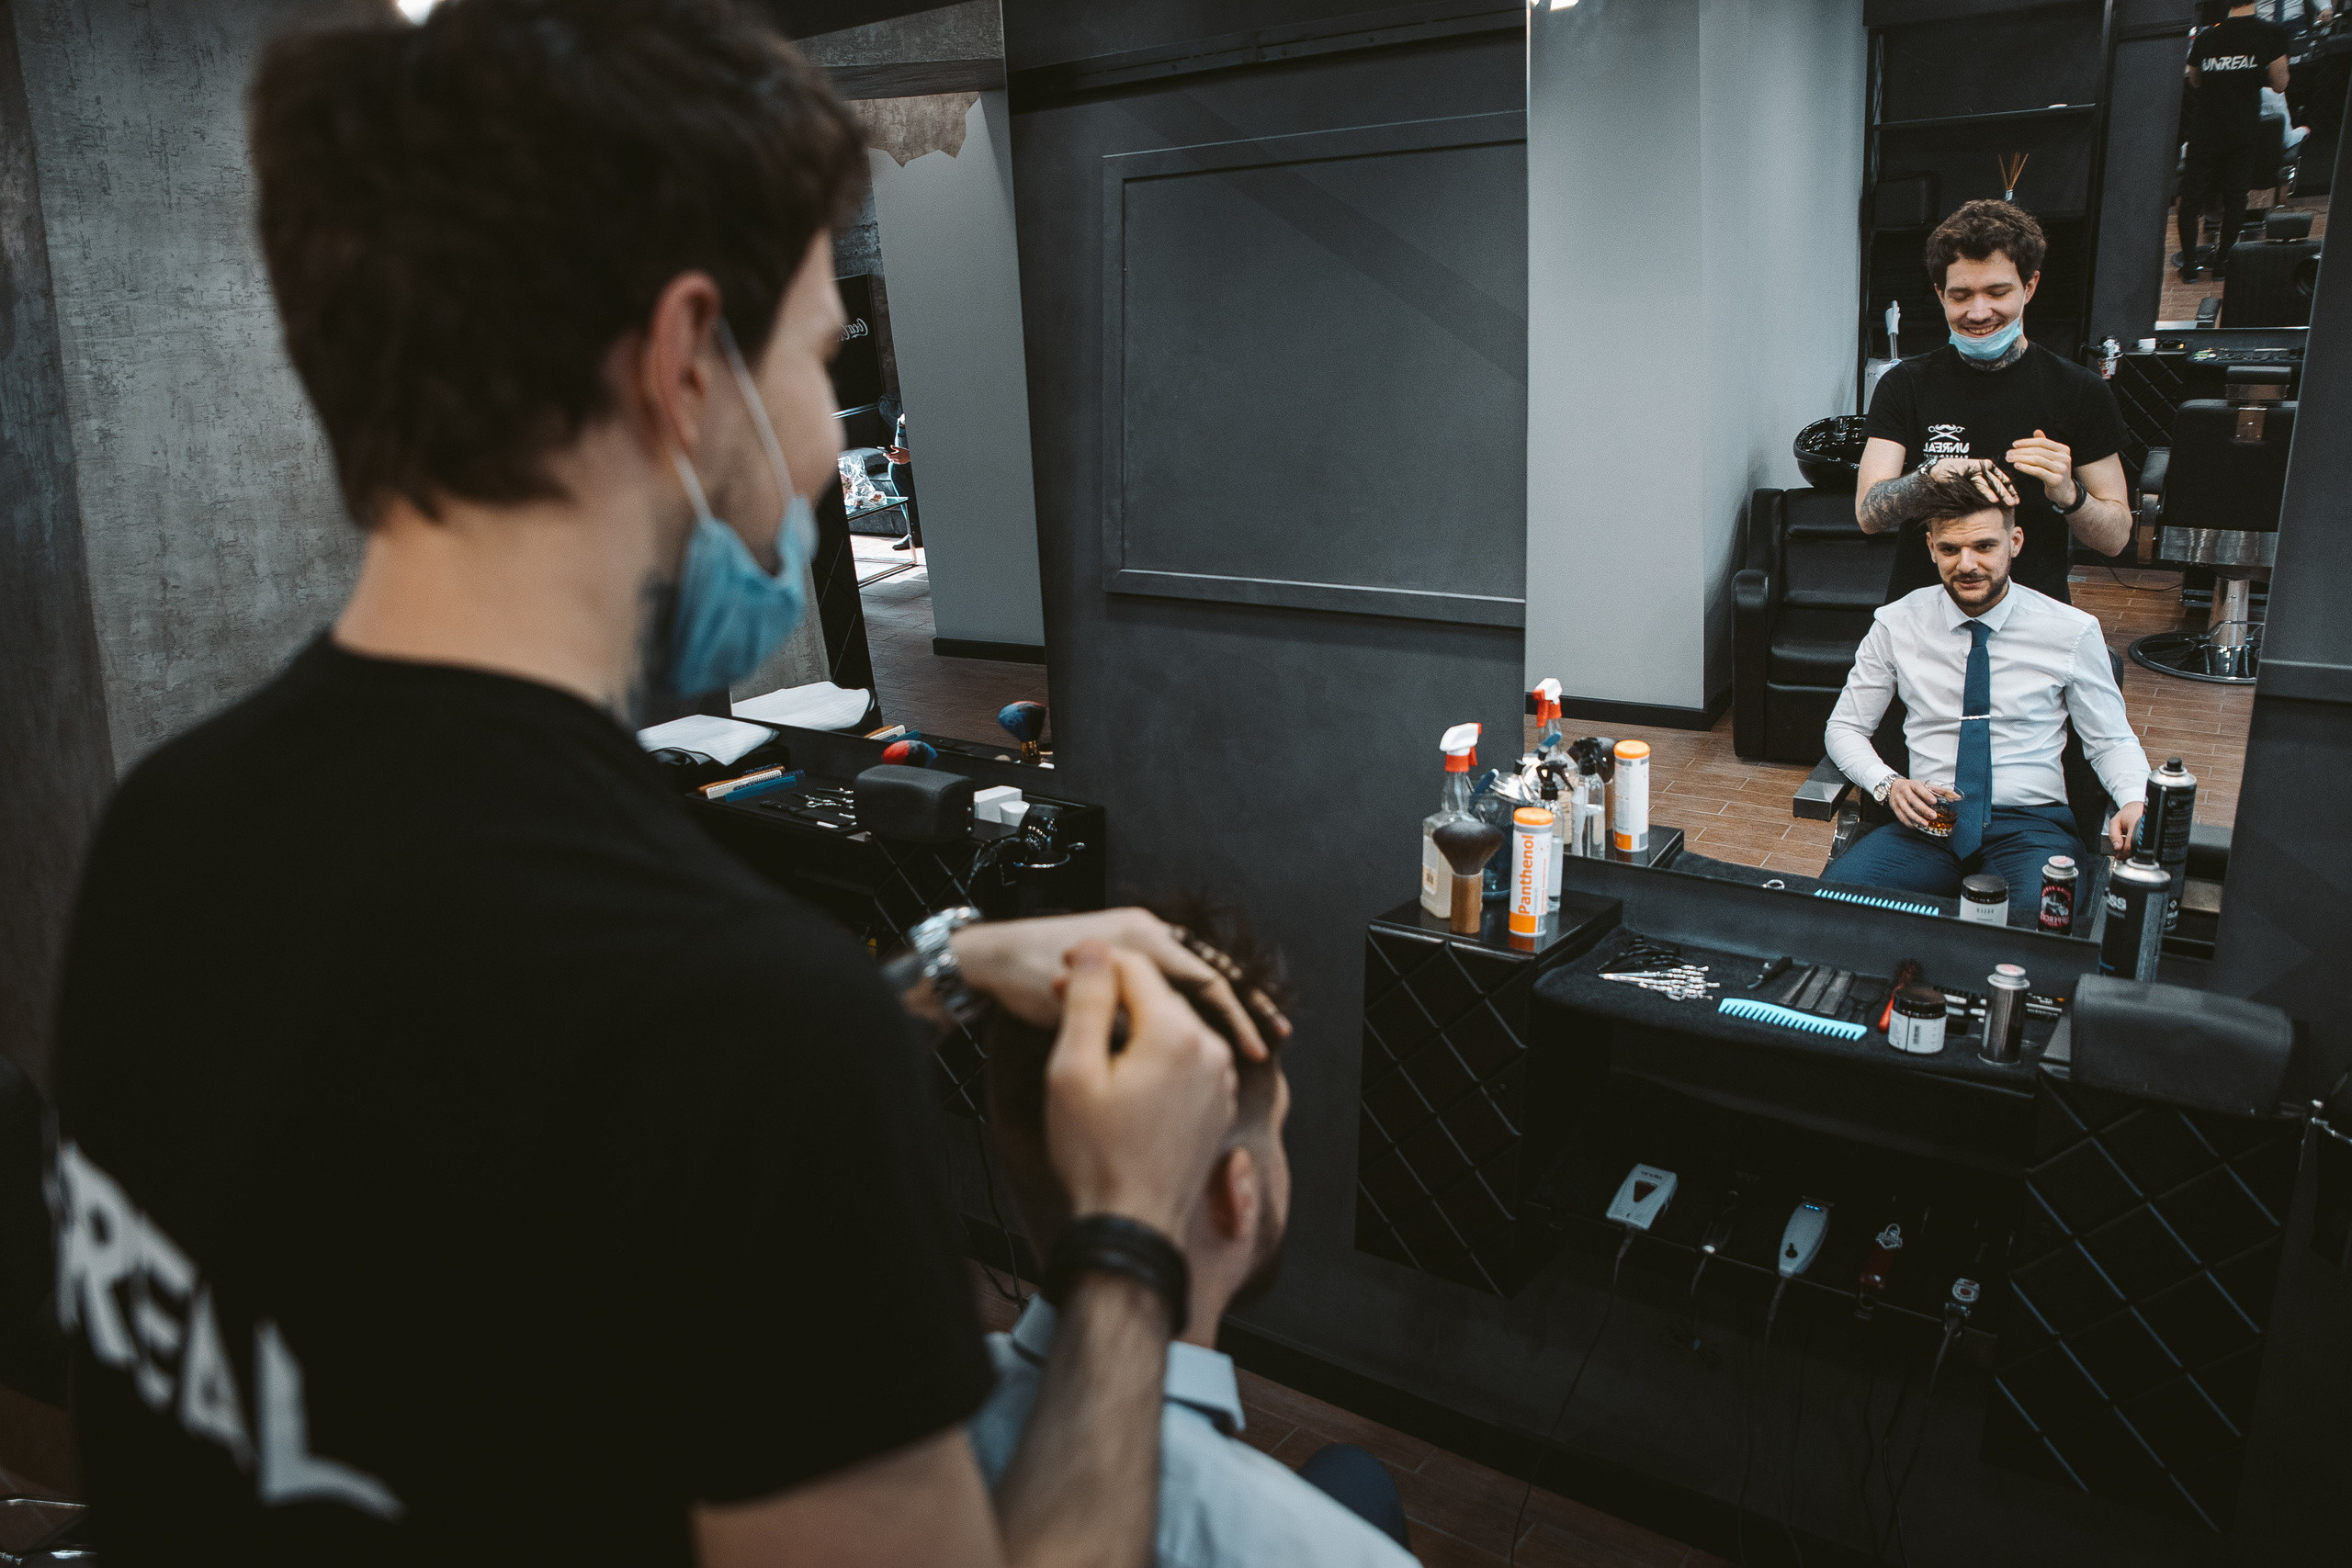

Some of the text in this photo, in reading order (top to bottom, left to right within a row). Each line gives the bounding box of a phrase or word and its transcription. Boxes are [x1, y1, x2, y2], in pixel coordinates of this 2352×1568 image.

[2201, 55, 2258, 73] UNREAL
[1518, 834, 1534, 915] Panthenol
[44, 1137, 405, 1521] REAL
